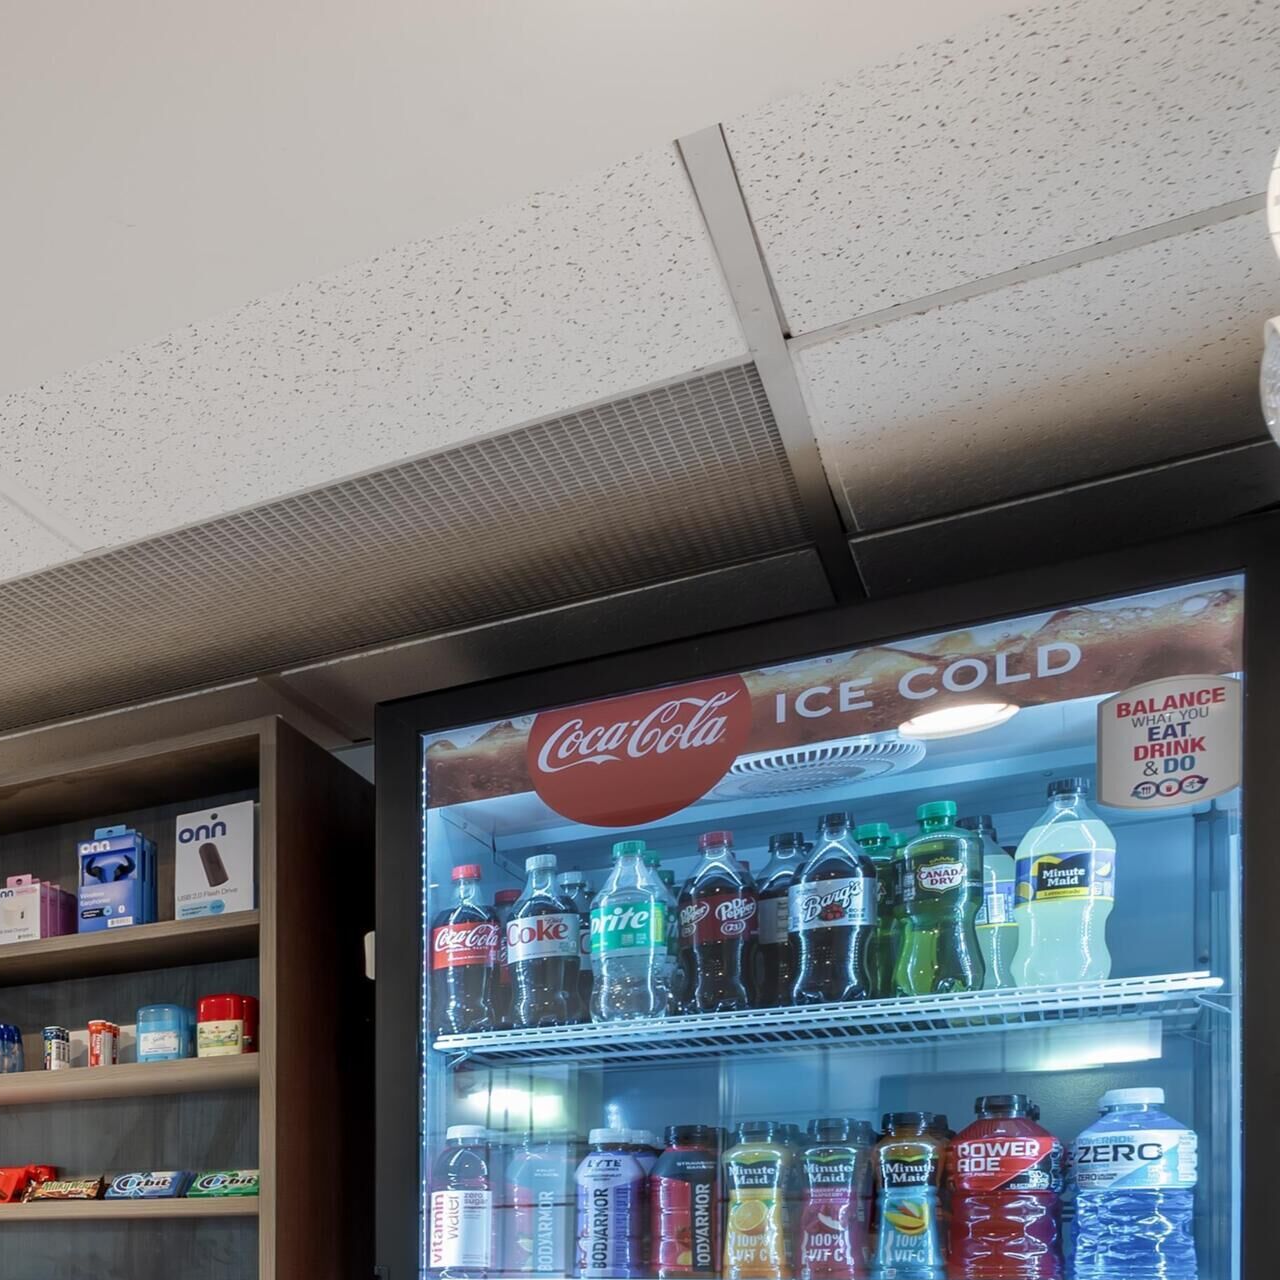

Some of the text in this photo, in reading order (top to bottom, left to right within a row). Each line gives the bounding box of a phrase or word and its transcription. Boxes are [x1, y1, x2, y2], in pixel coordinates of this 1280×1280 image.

[775, 641, 1081, 724] ICE COLD
[1116, 687, 1226, 718] BALANCE
[1131, 707, 1209, 728] WHAT YOU
[537, 689, 740, 773] Coca-Cola
[1134, 736, 1206, 761] DRINK
[1143, 755, 1195, 776] & DO
[178, 821, 226, 843] onn
[80, 840, 110, 854] onn
[930, 875, 954, 886] DRY
[1042, 867, 1085, 879] Minute
[1047, 876, 1079, 887] Maid
[802, 881, 862, 923] Barq's
[590, 907, 649, 932] prite
[435, 924, 499, 952] Coca-Cola
[507, 919, 568, 947] Coke
[957, 1141, 1040, 1157] POWER
[1078, 1143, 1163, 1163] ZERO
[729, 1166, 775, 1176] Minute
[804, 1163, 853, 1174] Minute
[886, 1162, 934, 1174] Minute
[958, 1157, 1001, 1172] ADE
[113, 1174, 172, 1193] Orbit
[197, 1174, 258, 1191] Orbit
[735, 1175, 768, 1185] Maid
[810, 1173, 845, 1182] Maid
[892, 1172, 927, 1183] Maid
[432, 1193, 444, 1264] vitamin
[536, 1190, 554, 1272] BODYARMOR
[592, 1187, 609, 1269] BODYARMOR
